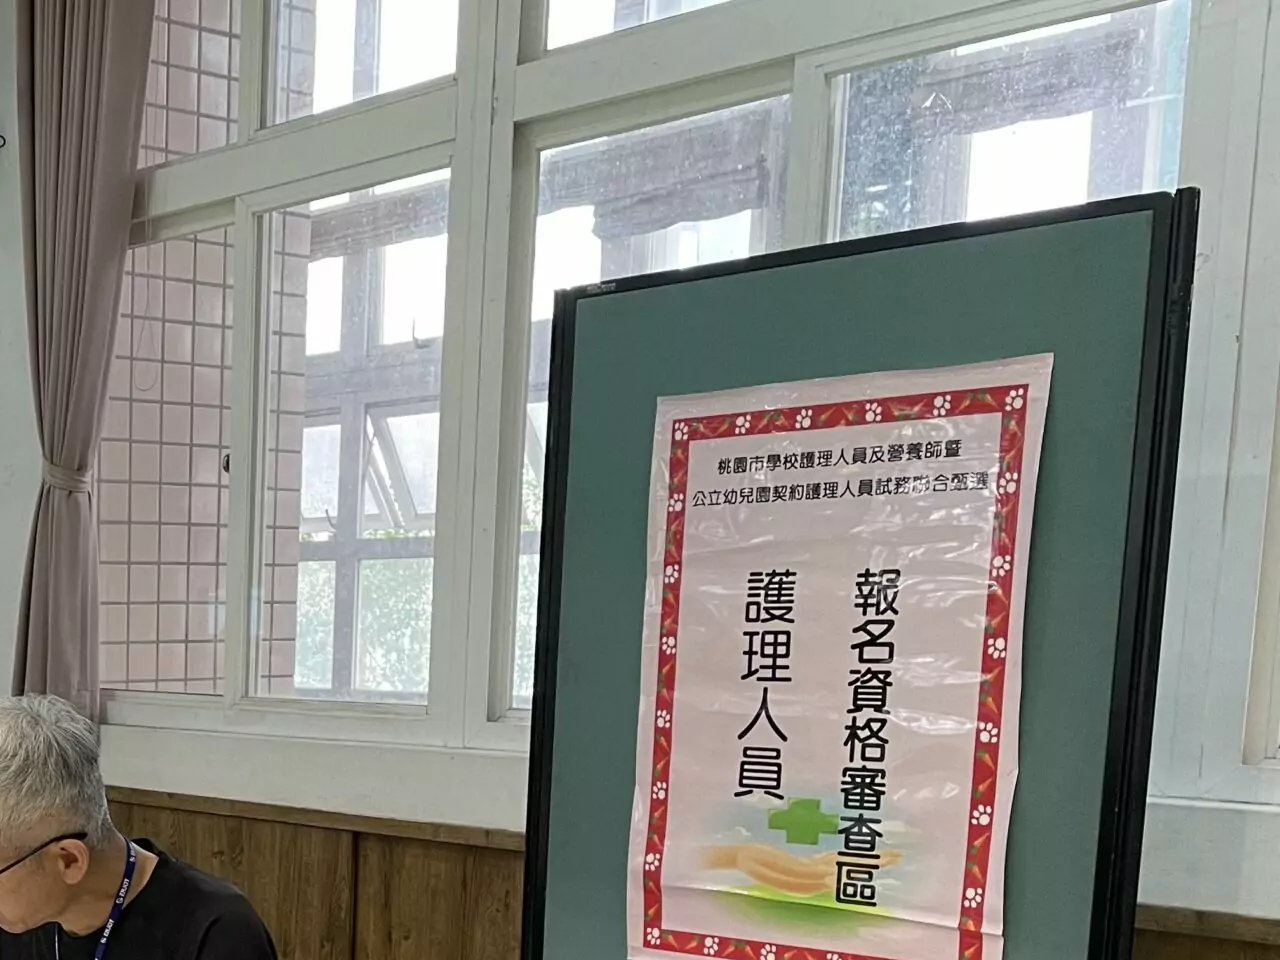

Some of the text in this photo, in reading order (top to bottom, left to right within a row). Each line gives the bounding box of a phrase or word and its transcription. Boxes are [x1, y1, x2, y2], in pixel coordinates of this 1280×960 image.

[692, 470, 989, 508] 公立幼兒園契約護理人員試務聯合甄選
[717, 439, 963, 475] 桃園市學校護理人員及營養師暨
[733, 569, 797, 801] 護理人員
[835, 568, 902, 908] 報名資格審查區
